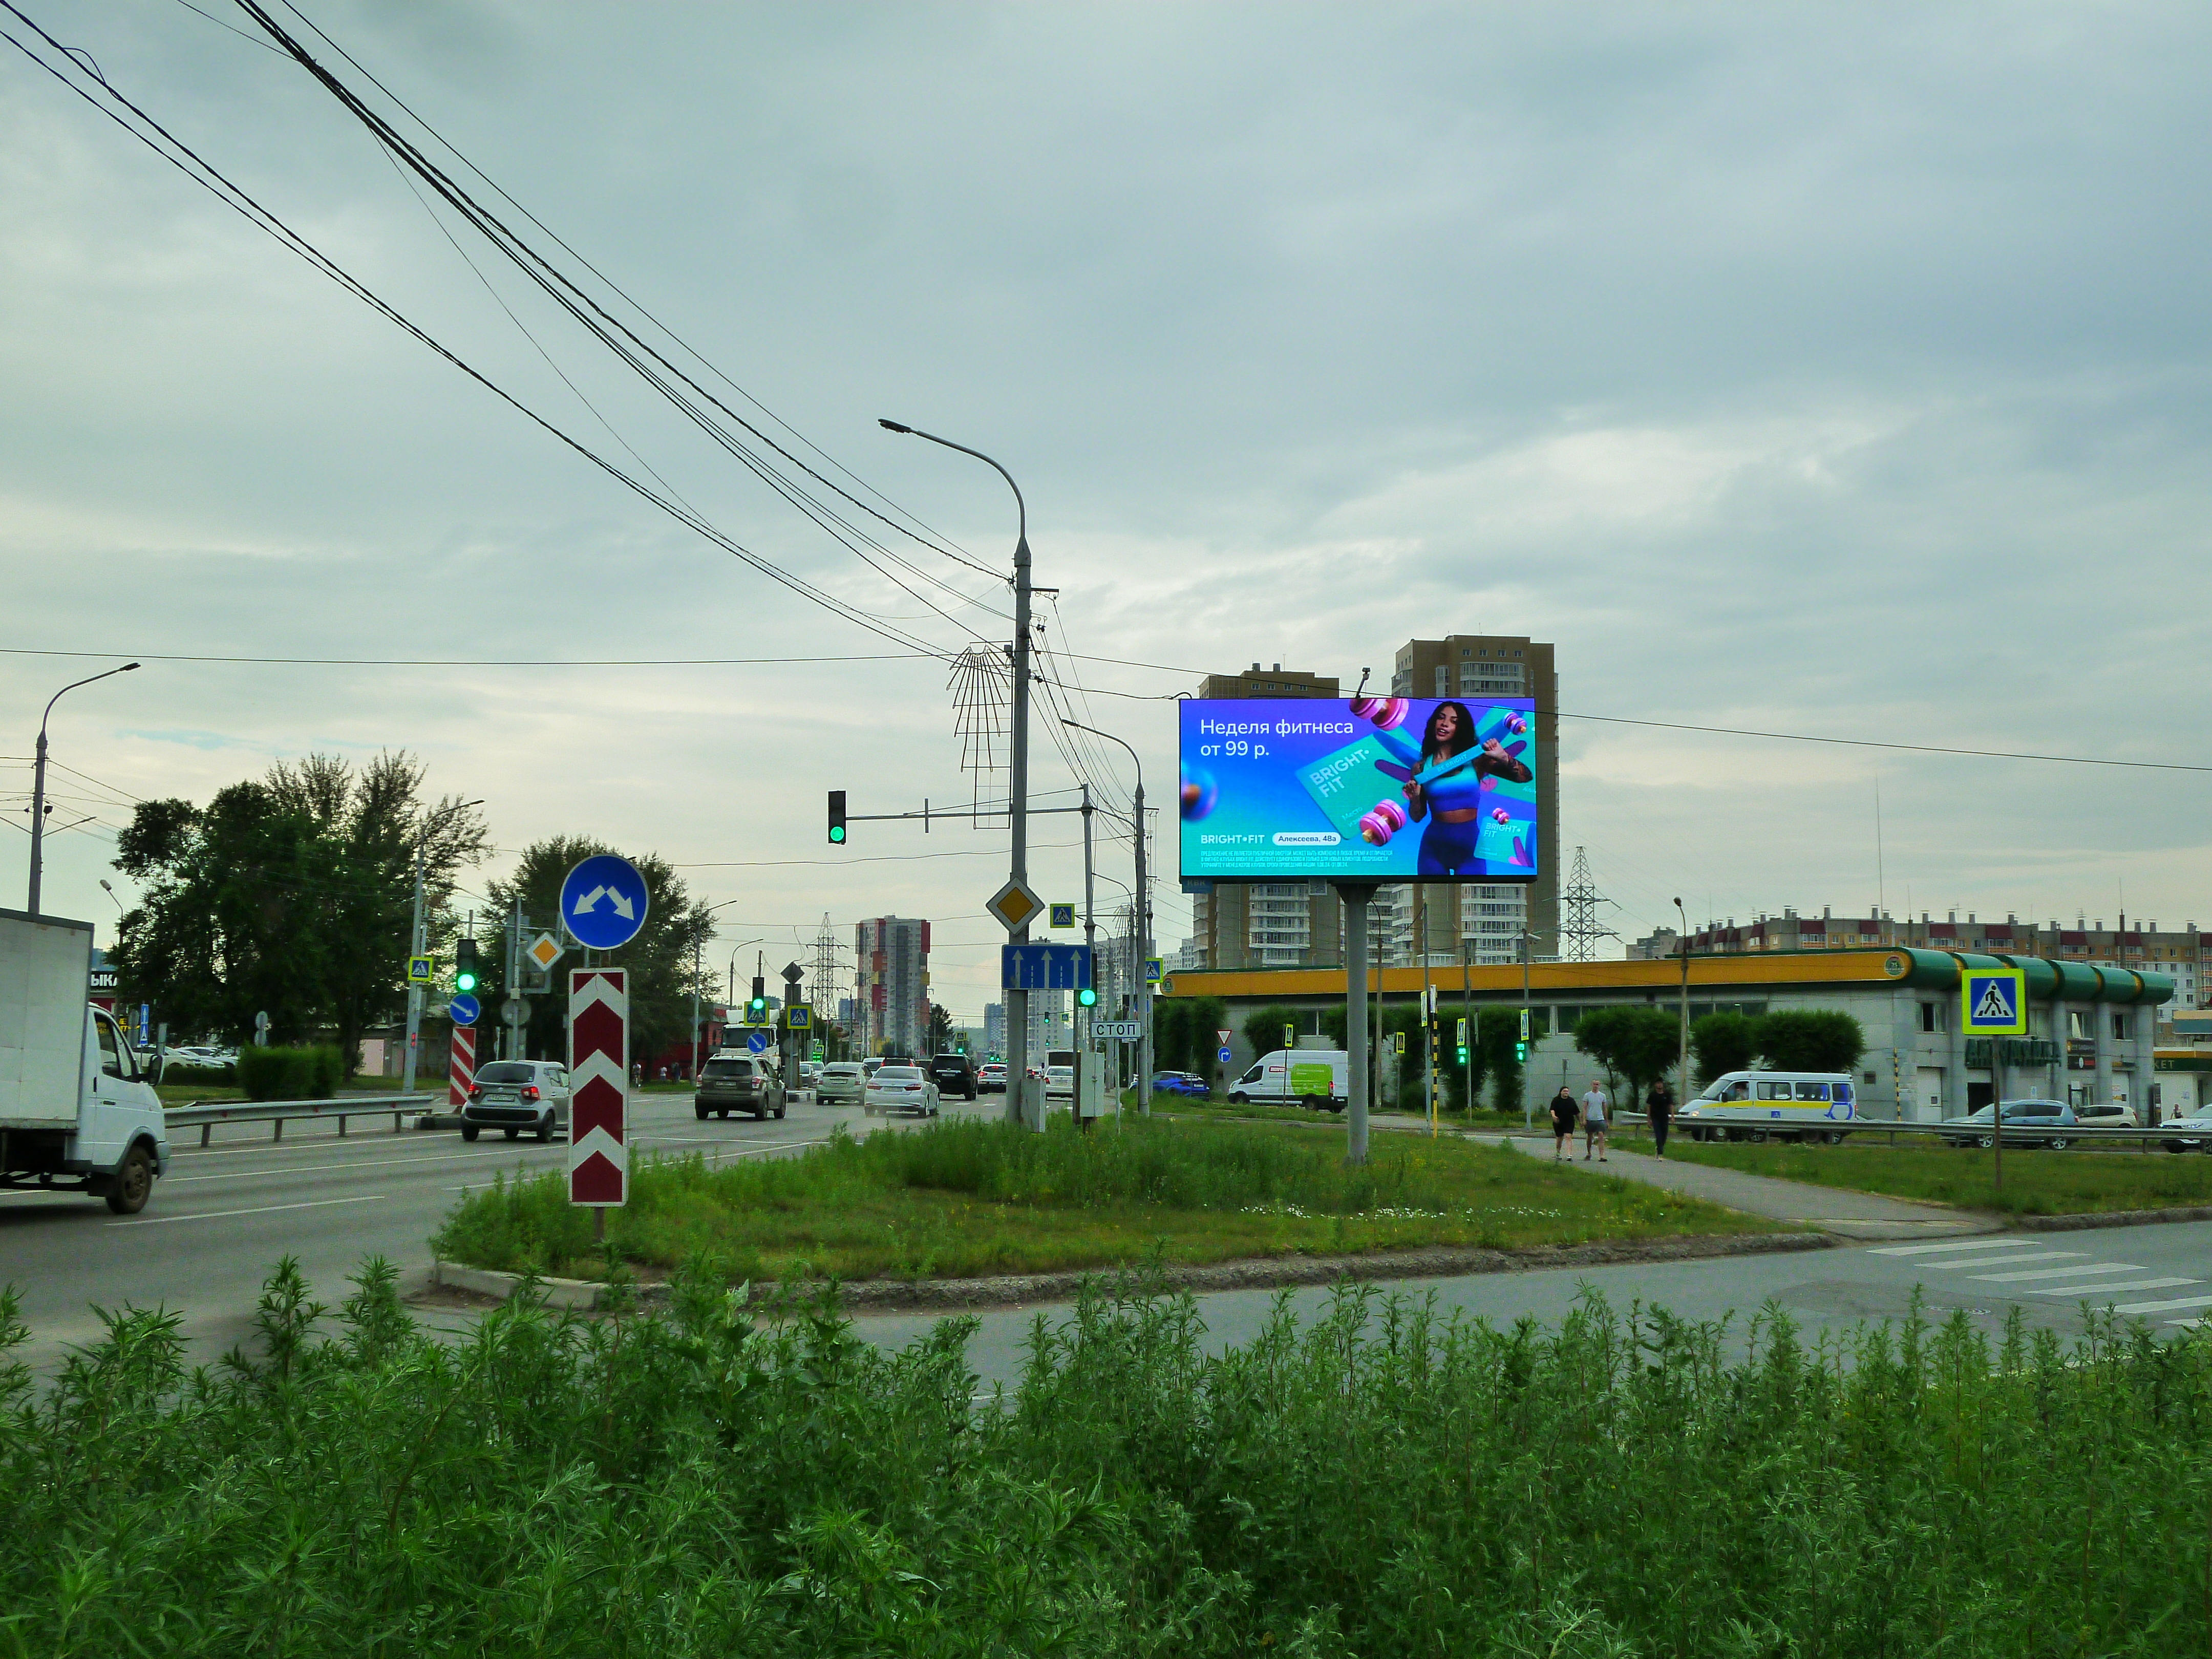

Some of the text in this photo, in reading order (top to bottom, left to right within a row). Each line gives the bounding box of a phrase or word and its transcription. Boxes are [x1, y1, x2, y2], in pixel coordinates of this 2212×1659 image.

[1201, 719, 1353, 737] Неделя фитнеса
[1201, 740, 1269, 759] от 99 р.
[1445, 754, 1467, 768] BRIGHT
[1318, 776, 1345, 798] FIT
[1096, 1024, 1135, 1035] СТОП
